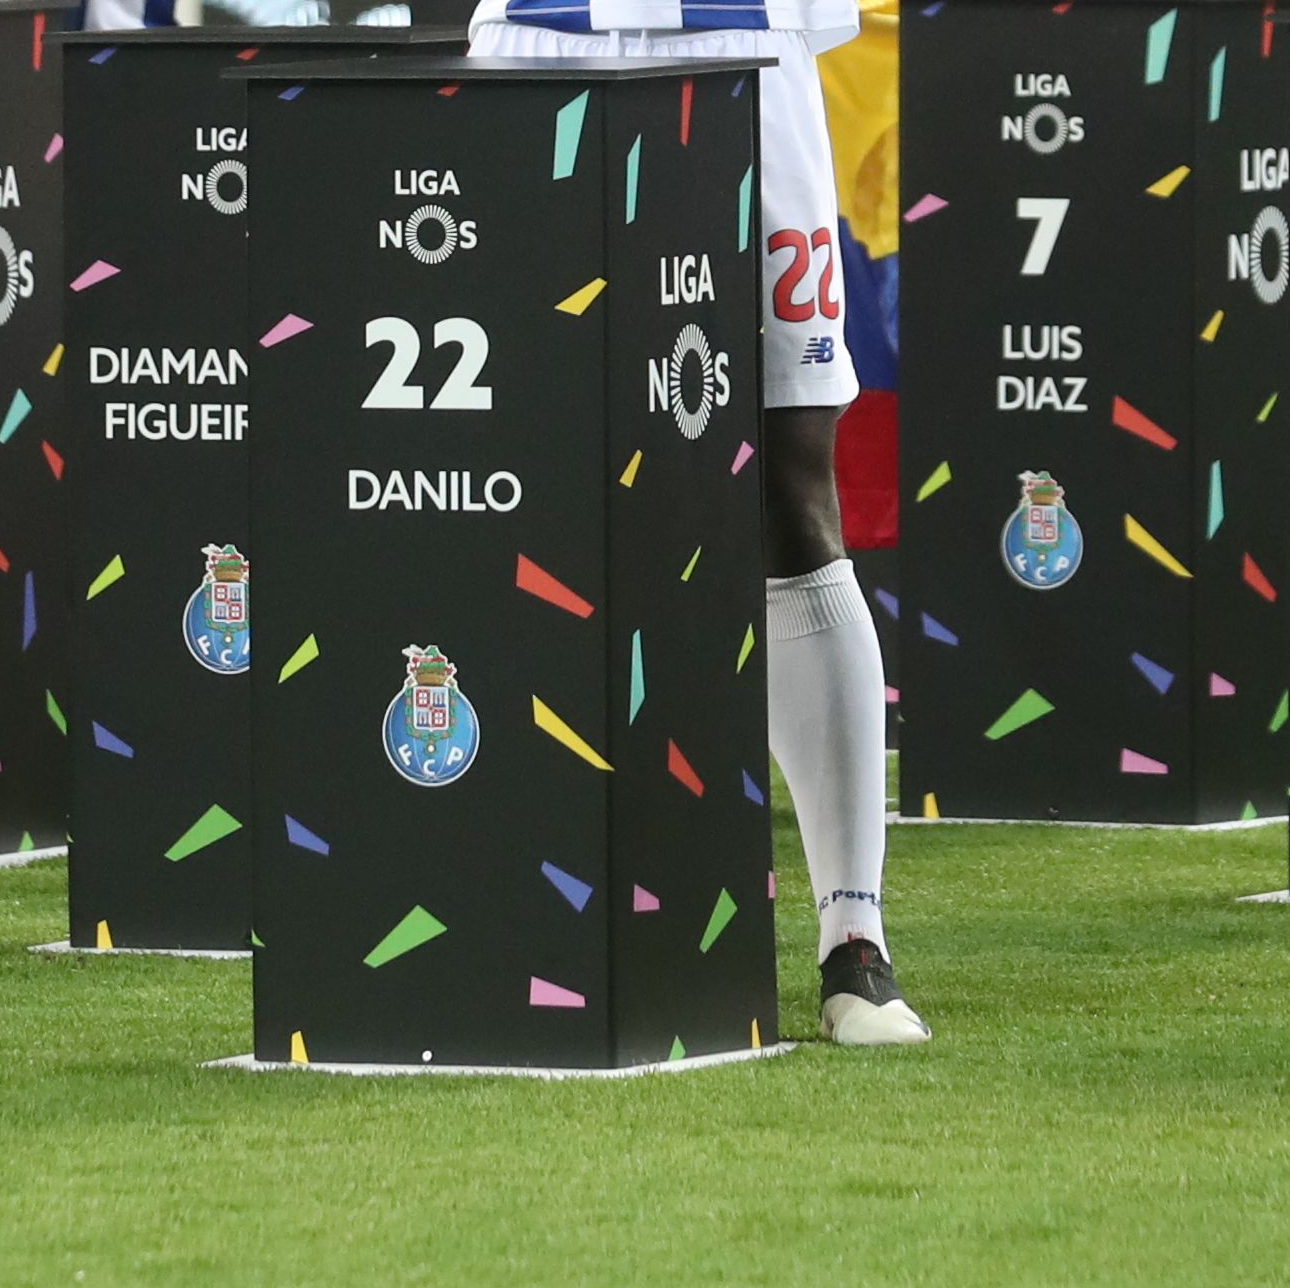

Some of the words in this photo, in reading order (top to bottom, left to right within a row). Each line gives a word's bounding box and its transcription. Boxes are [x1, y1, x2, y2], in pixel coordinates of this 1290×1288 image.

[1015, 74, 1071, 97] LIGA
[1002, 103, 1084, 153] NOS
[395, 170, 460, 195] LIGA
[1240, 147, 1290, 192] LIGA
[380, 205, 477, 264] NOS
[1017, 198, 1070, 275] 7
[661, 254, 715, 305] LIGA
[768, 227, 839, 323] 22
[361, 317, 492, 410] 22
[1003, 325, 1082, 360] LUIS
[649, 324, 730, 439] NOS
[998, 376, 1088, 412] DIAZ
[349, 470, 521, 512] DANILO
